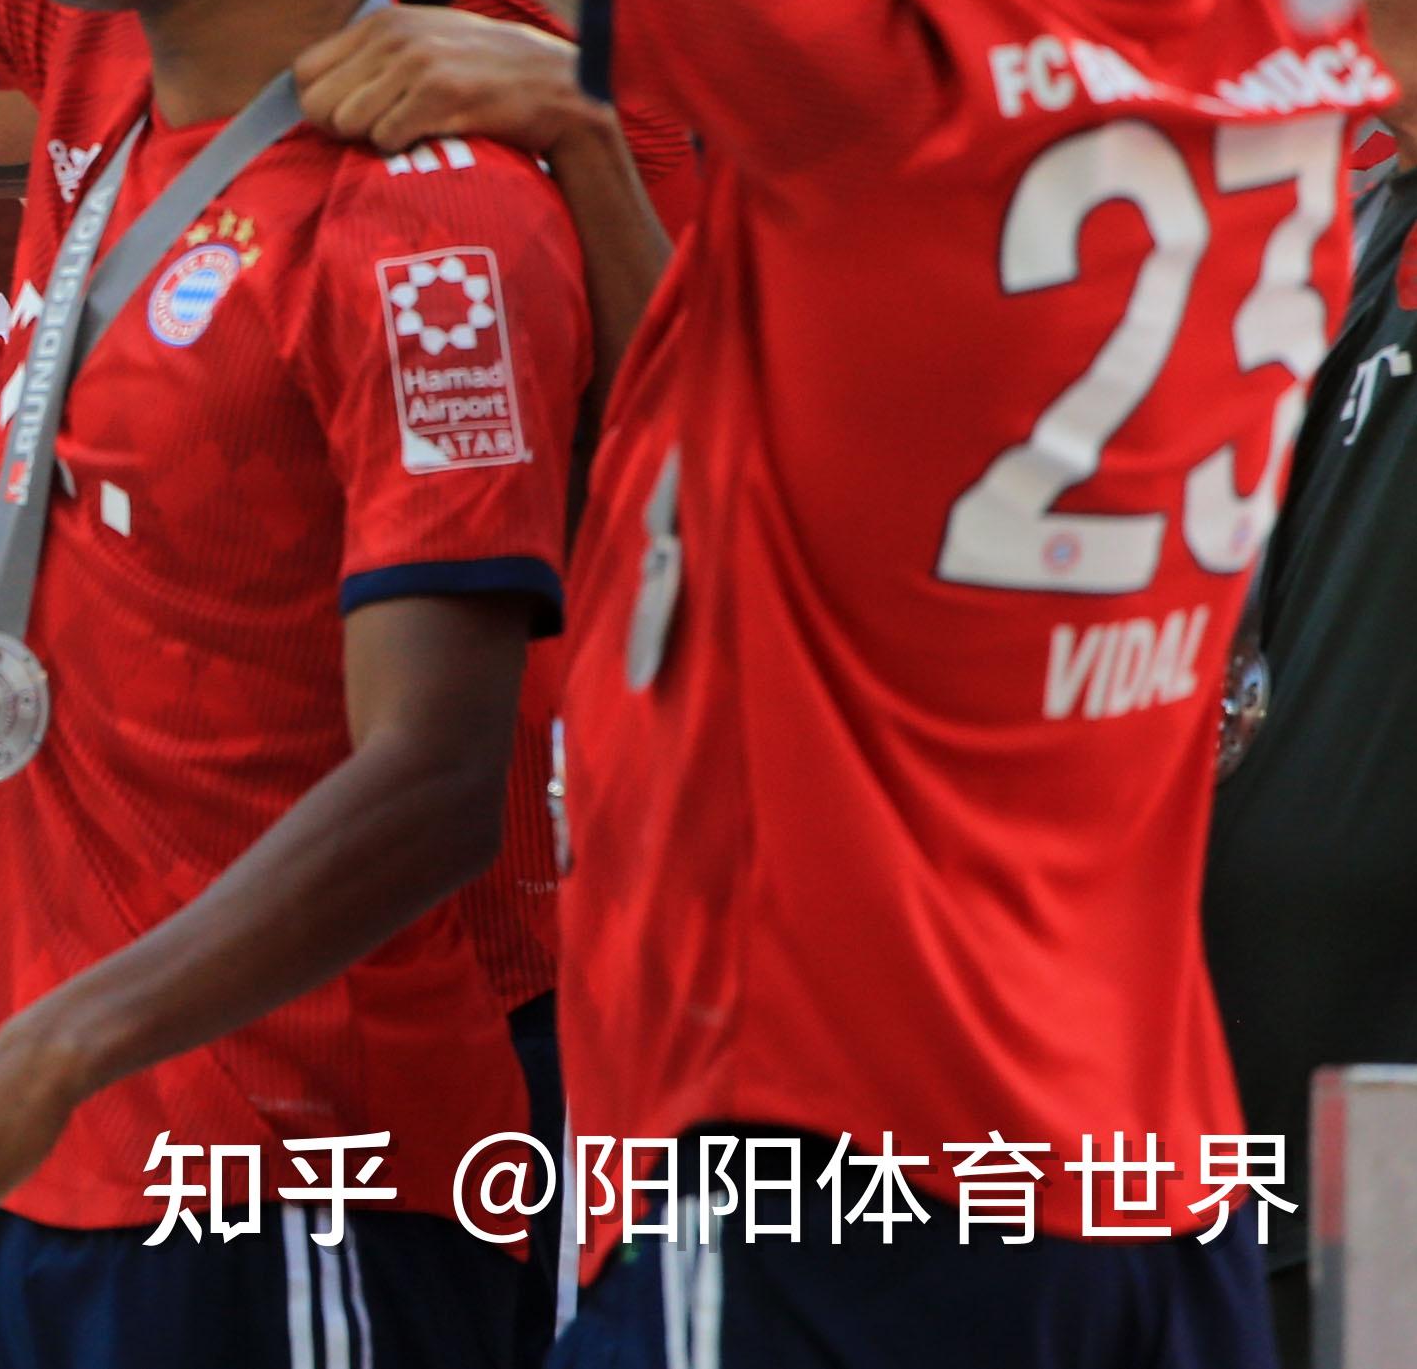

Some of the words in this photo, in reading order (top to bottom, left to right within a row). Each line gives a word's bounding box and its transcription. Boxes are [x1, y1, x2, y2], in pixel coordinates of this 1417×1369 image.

[988, 34, 1076, 118] FC
[403, 363, 506, 394] Hamad
[935, 116, 1348, 594] 23
[409, 392, 508, 425] Airport
[1042, 605, 1211, 720] VIDAL
